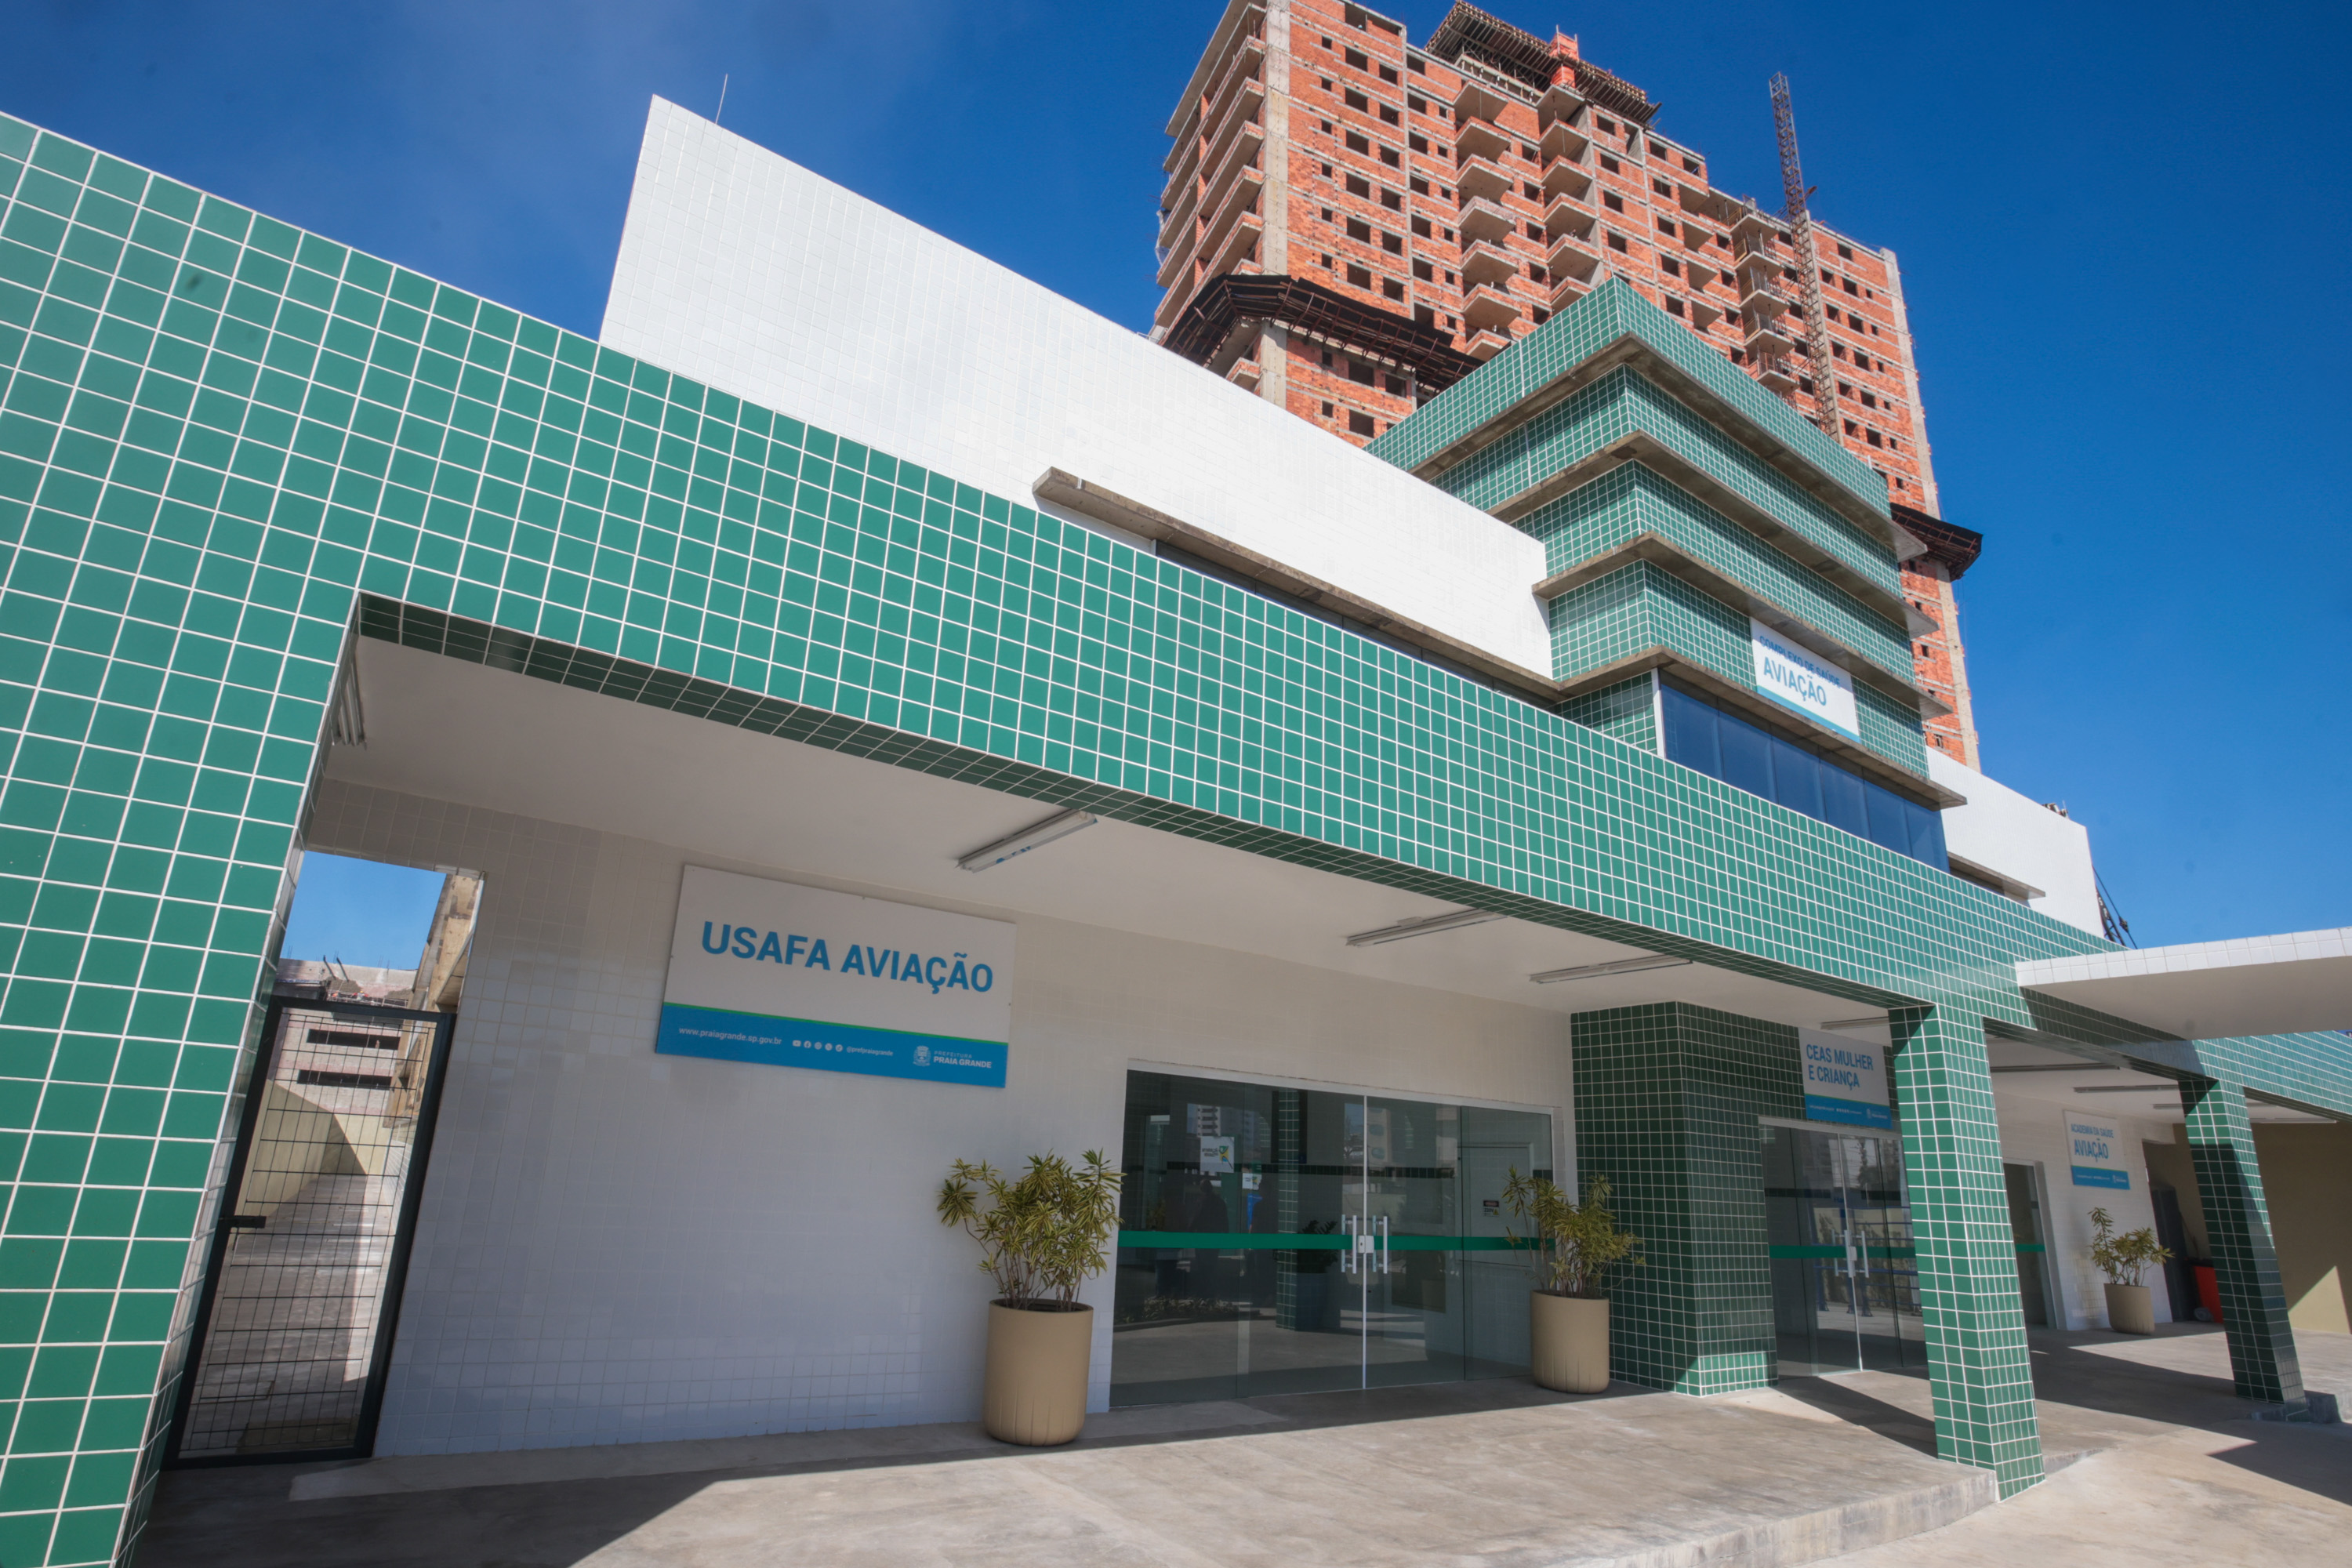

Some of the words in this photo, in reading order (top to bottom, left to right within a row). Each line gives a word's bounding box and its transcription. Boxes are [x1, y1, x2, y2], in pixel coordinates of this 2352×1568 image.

[1759, 635, 1803, 667] COMPLEXO
[1805, 660, 1815, 674] DE
[1817, 667, 1842, 688] SAÚDE
[1764, 656, 1827, 706] AVIAÇÃO
[701, 920, 830, 971] USAFA
[840, 944, 993, 994] AVIAÇÃO
[679, 1026, 782, 1045] www.praiagrande.sp.gov.br
[846, 1045, 894, 1057] @prefpraiagrande
[933, 1056, 958, 1065] PRAIA
[959, 1058, 992, 1069] GRANDE
[1806, 1044, 1832, 1063] CEAS
[1835, 1049, 1874, 1071] MULHER
[1808, 1065, 1815, 1080] E
[1817, 1065, 1860, 1091] CRIANÇA
[2074, 1138, 2109, 1163] AVIAÇÃO
